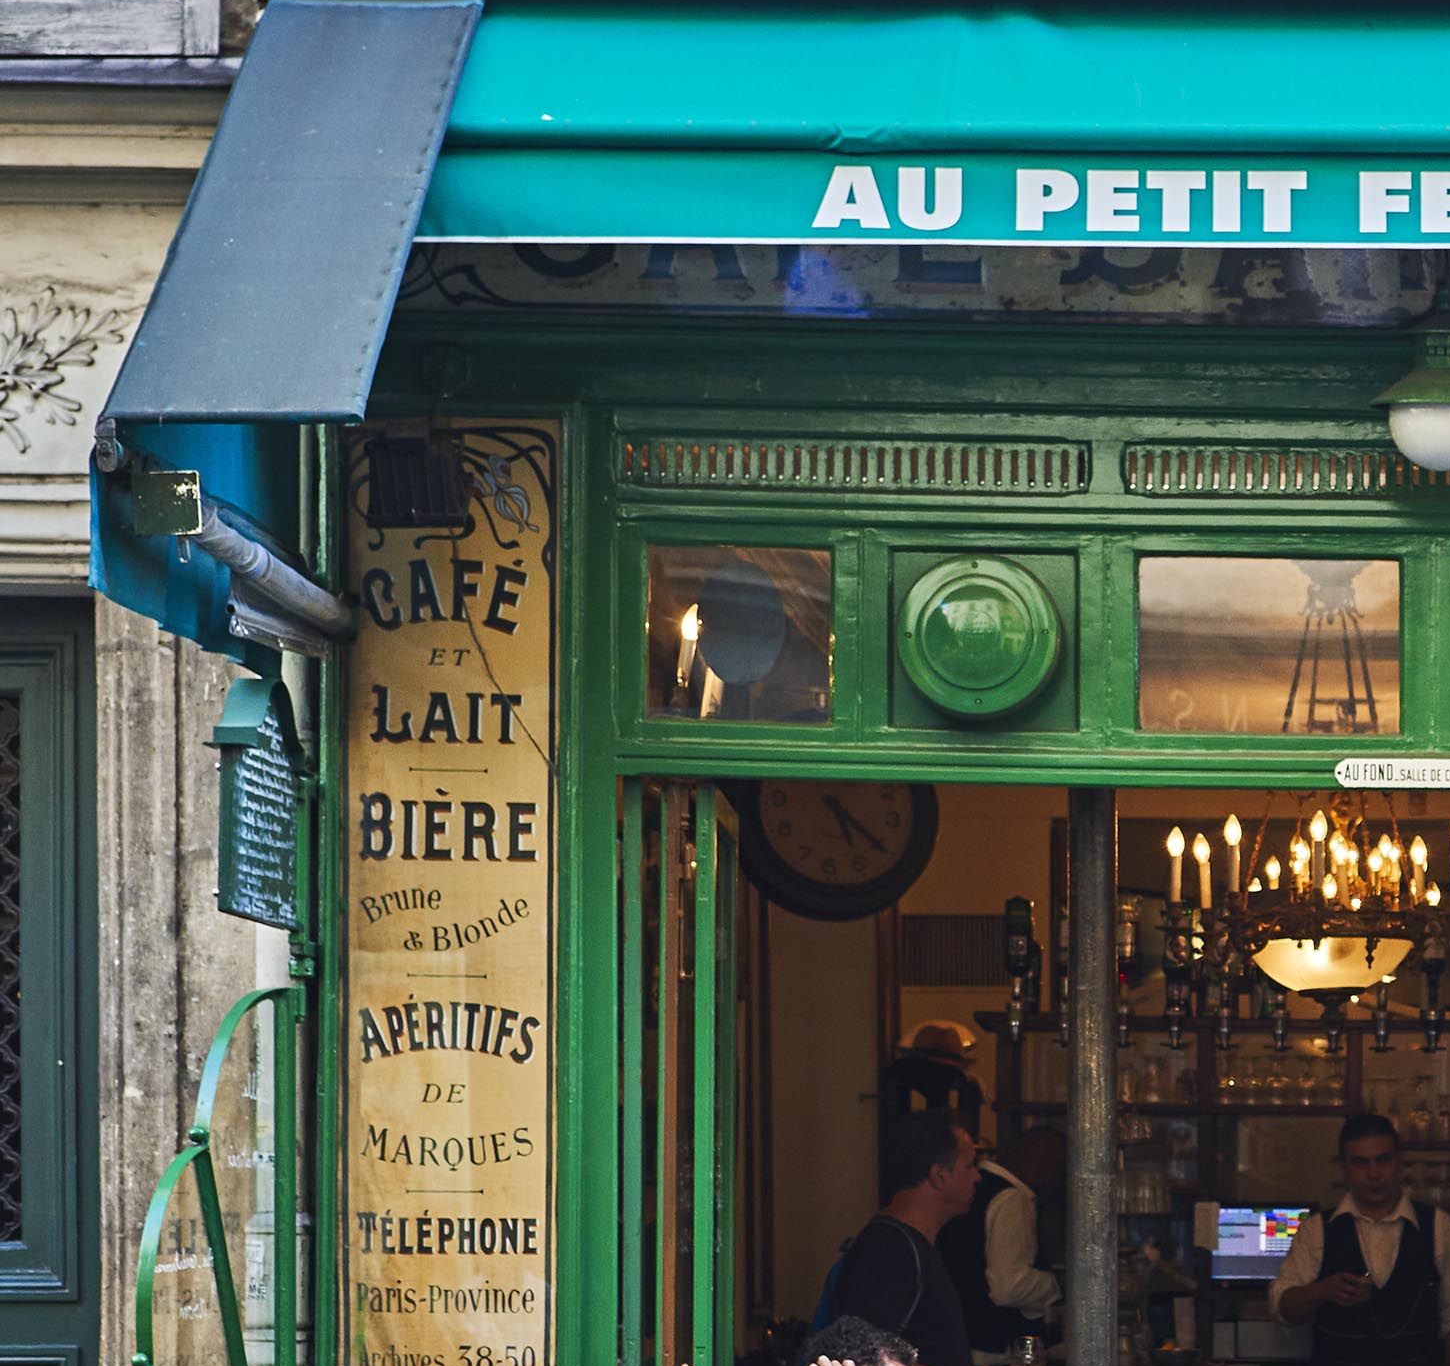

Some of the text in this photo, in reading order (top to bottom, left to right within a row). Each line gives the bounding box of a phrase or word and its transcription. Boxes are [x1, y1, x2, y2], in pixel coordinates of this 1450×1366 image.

[813, 166, 962, 231] AU
[1015, 169, 1307, 233] PETIT
[361, 556, 530, 636] CAFÉ
[428, 647, 470, 668] ET
[369, 684, 523, 745] LAIT
[1344, 763, 1360, 781] AU
[1364, 763, 1394, 781] FOND
[1400, 769, 1427, 781] SALLE
[1430, 769, 1441, 781] DE
[359, 787, 541, 863] BIÈRE
[361, 884, 442, 925] Brune
[403, 893, 530, 953] & Blonde
[359, 993, 541, 1064] APÉRITIFS
[421, 1082, 467, 1104] DE
[360, 1124, 535, 1171] MARQUES
[356, 1209, 539, 1257] TÉLÉPHONE
[356, 1281, 535, 1315] Paris-Province
